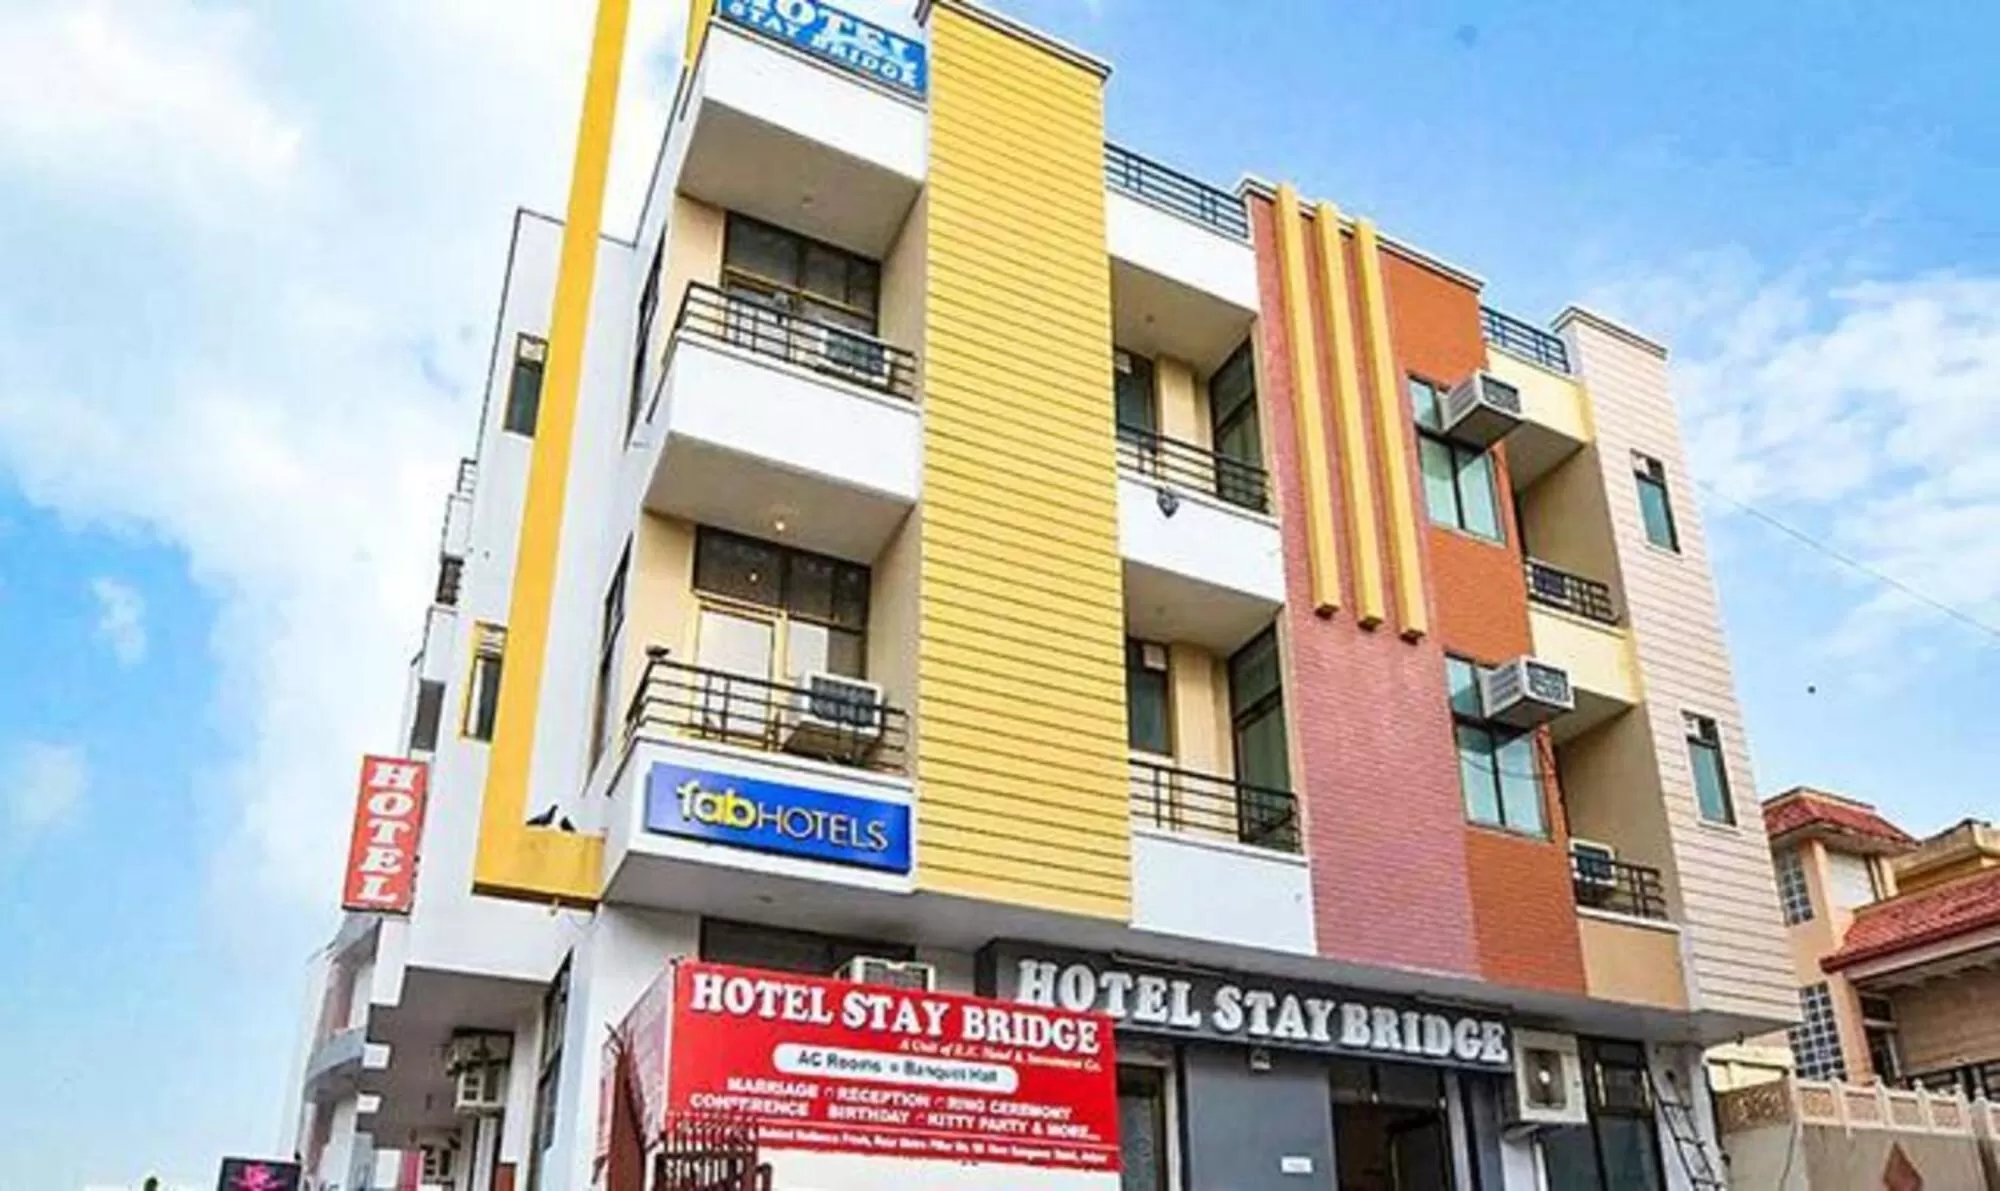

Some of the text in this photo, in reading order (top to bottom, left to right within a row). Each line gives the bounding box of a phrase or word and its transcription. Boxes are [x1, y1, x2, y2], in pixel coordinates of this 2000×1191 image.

[729, 1, 918, 87] STAY BRIDGE
[357, 762, 420, 903] HOTEL
[676, 780, 888, 850] fabHOTELS
[691, 973, 1100, 1055] HOTEL STAY BRIDGE
[1014, 958, 1201, 1028] HOTEL
[799, 1050, 822, 1068] AC
[827, 1053, 882, 1074] Rooms
[727, 1077, 1072, 1121] MARRIAGE RECEPTION RING CEREMONY
[828, 1103, 910, 1124] BIRTHDAY
[927, 1112, 975, 1131] KITTY
[979, 1116, 1028, 1135] PARTY
[1031, 1121, 1043, 1136] &
